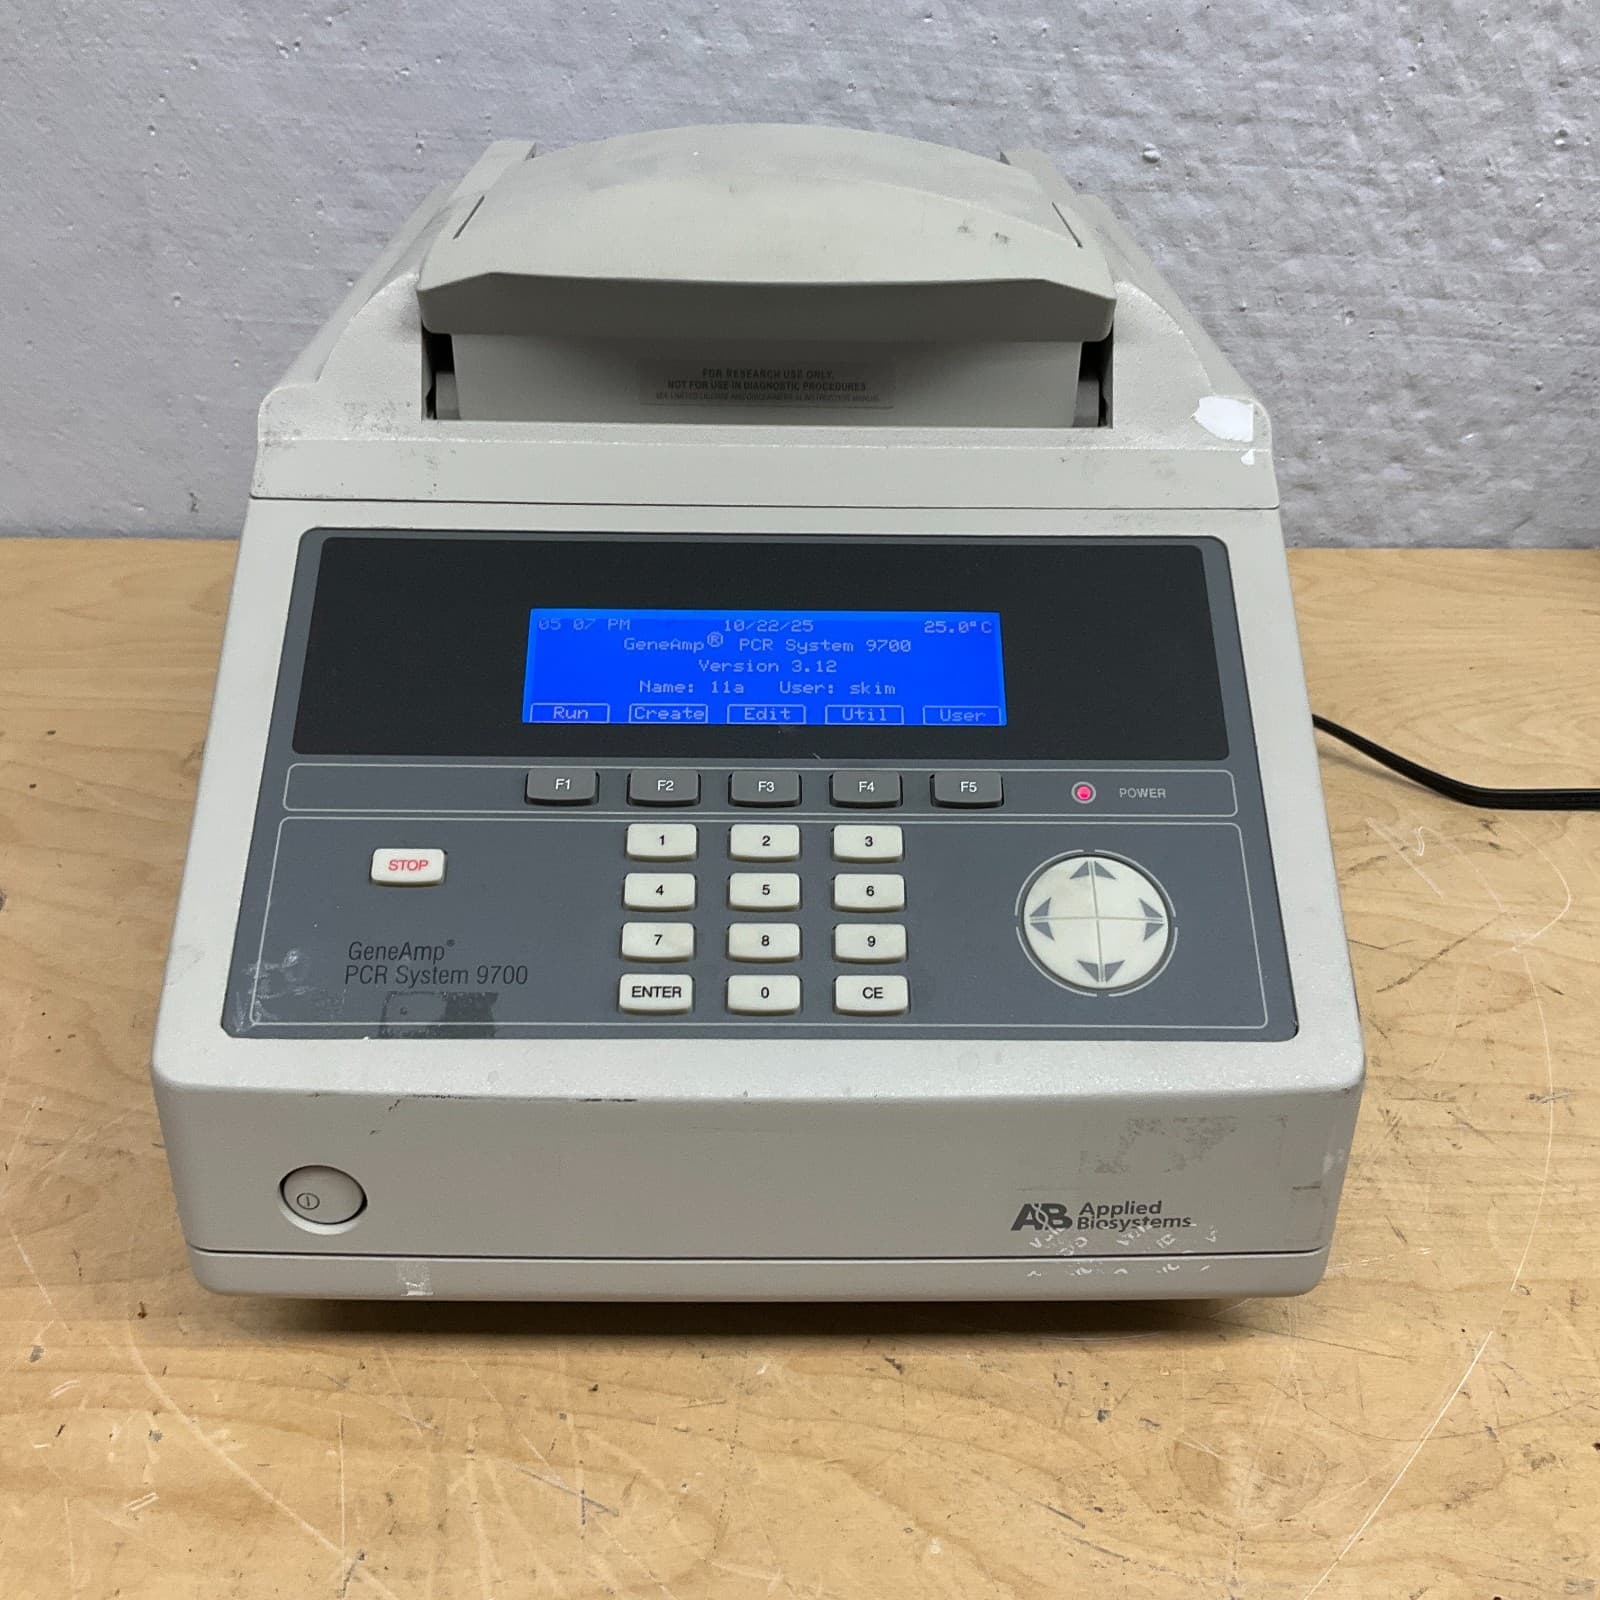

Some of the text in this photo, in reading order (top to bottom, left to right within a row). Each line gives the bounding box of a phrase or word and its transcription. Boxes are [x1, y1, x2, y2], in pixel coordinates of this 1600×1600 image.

[702, 369, 722, 378] FOR
[726, 369, 780, 378] RESEARCH
[783, 369, 802, 379] USE
[667, 380, 687, 389] NOT
[689, 380, 709, 389] FOR
[711, 380, 728, 390] USE
[732, 381, 742, 390] IN
[744, 381, 799, 391] DIAGNOSTIC
[538, 618, 561, 631] 05
[608, 619, 631, 631] PM
[724, 620, 814, 633] 10/22/25
[739, 638, 774, 652] PCR
[785, 638, 854, 654] System
[866, 639, 912, 653] 9700
[699, 659, 837, 673] Version 3.12
[639, 680, 695, 694] Name:
[780, 681, 834, 695] User:
[849, 681, 896, 695] skim
[553, 707, 588, 720] Run
[634, 707, 707, 721] Create
[744, 707, 791, 721] Edit
[842, 707, 888, 721] Util
[940, 708, 986, 722] User
[555, 778, 571, 791] F1
[657, 779, 674, 792] F2
[758, 780, 775, 793] F3
[858, 781, 875, 793] F4
[960, 781, 977, 793] F5
[1119, 788, 1167, 798] POWER
[659, 835, 665, 846] 1
[762, 836, 771, 846] 2
[864, 836, 873, 847] 3
[388, 859, 428, 871] STOP
[656, 885, 665, 896] 4
[761, 885, 771, 896] 5
[866, 886, 875, 897] 6
[654, 935, 663, 946] 7
[760, 935, 770, 947] 8
[866, 935, 876, 948] 9
[345, 965, 528, 988] PCR System 9700
[631, 986, 682, 998] ENTER
[760, 987, 770, 999] 0
[862, 987, 883, 1000] CE
[1080, 1201, 1162, 1218] Applied
[1077, 1216, 1192, 1232] Biosystems
